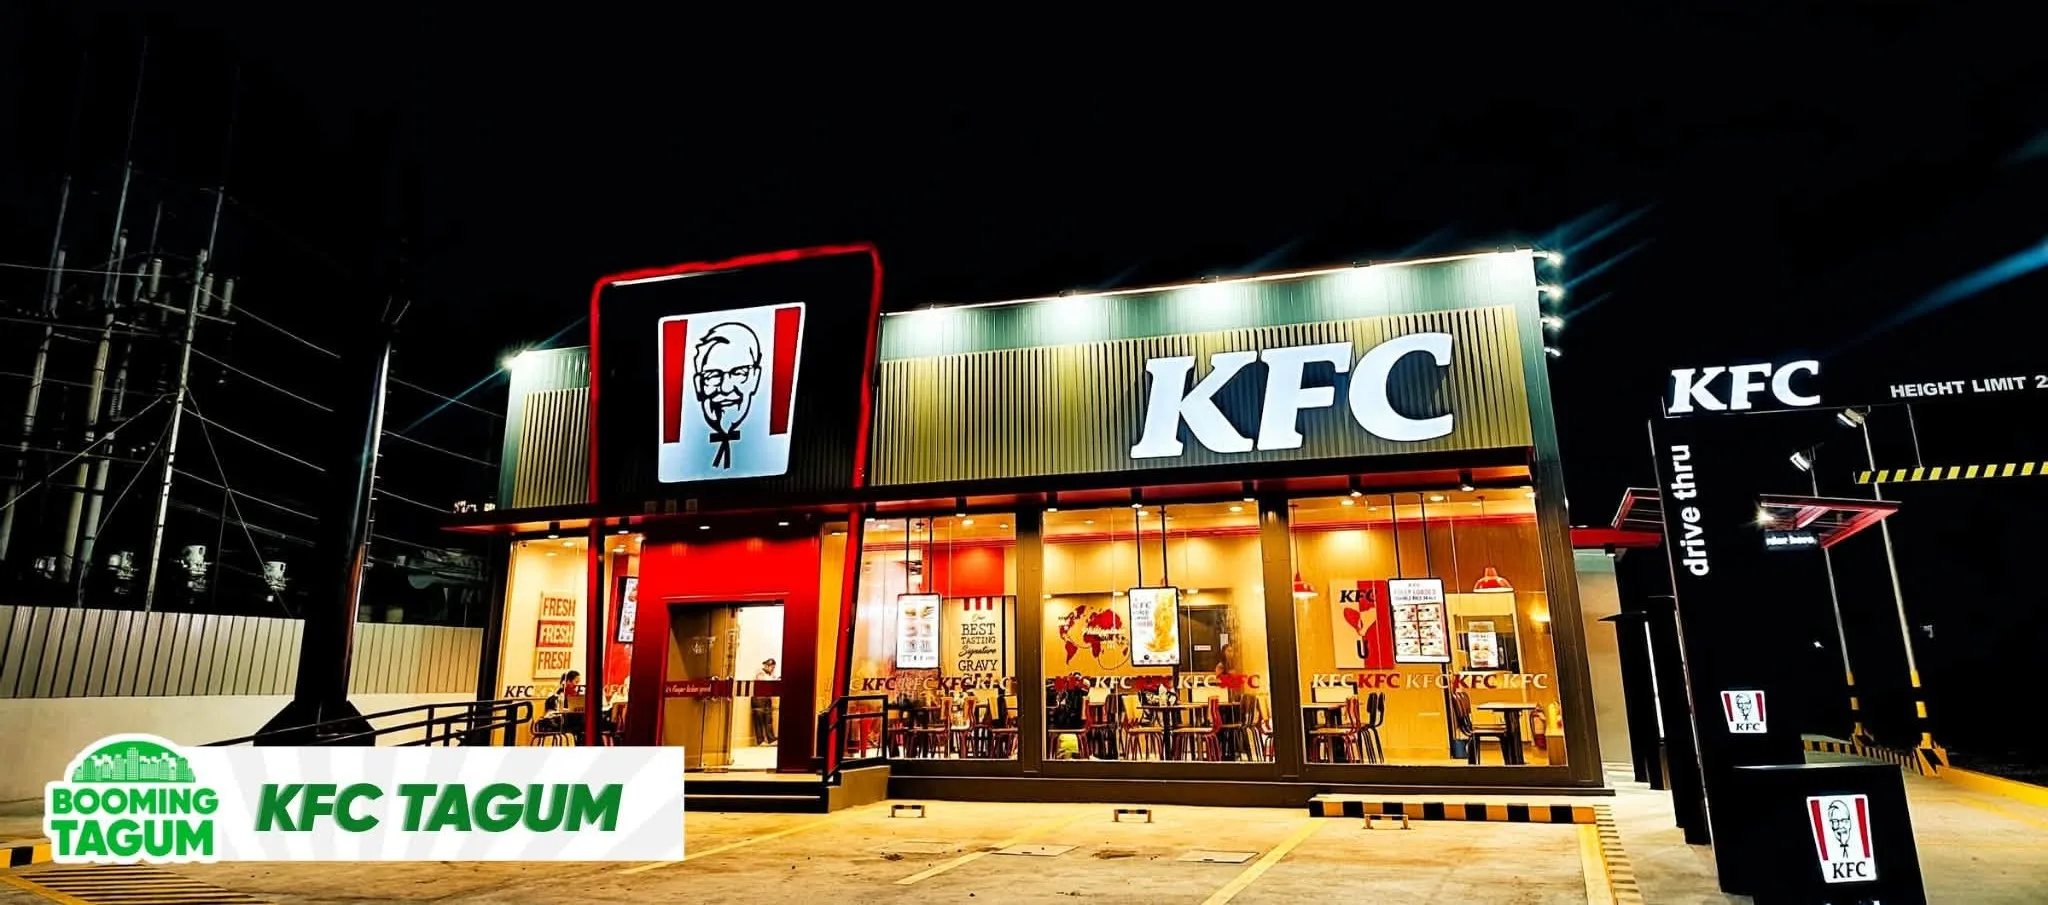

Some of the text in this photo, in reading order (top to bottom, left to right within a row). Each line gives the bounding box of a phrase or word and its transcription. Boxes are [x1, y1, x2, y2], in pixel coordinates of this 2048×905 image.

[1131, 332, 1455, 458] KFC
[1668, 360, 1821, 415] KFC
[1891, 380, 1965, 398] HEIGHT
[1971, 376, 2027, 393] LIMIT
[1671, 444, 1709, 577] drive thru
[1339, 588, 1379, 604] KFC
[543, 597, 577, 618] FRESH
[541, 623, 575, 645] FRESH
[961, 623, 996, 636] BEST
[960, 636, 997, 645] TASTING
[958, 645, 997, 659] Signature
[1356, 640, 1368, 659] U
[538, 651, 571, 670] FRESH
[958, 659, 998, 672] GRAVY
[862, 677, 896, 691] KFC
[937, 677, 973, 691] KFC
[1095, 676, 1133, 689] KFC
[1177, 675, 1216, 689] KFC
[1312, 673, 1548, 689] KFC KFC KFC KFC KFC
[504, 685, 534, 698] KFC
[1735, 723, 1762, 732] KFC
[1832, 861, 1868, 880] KFC
